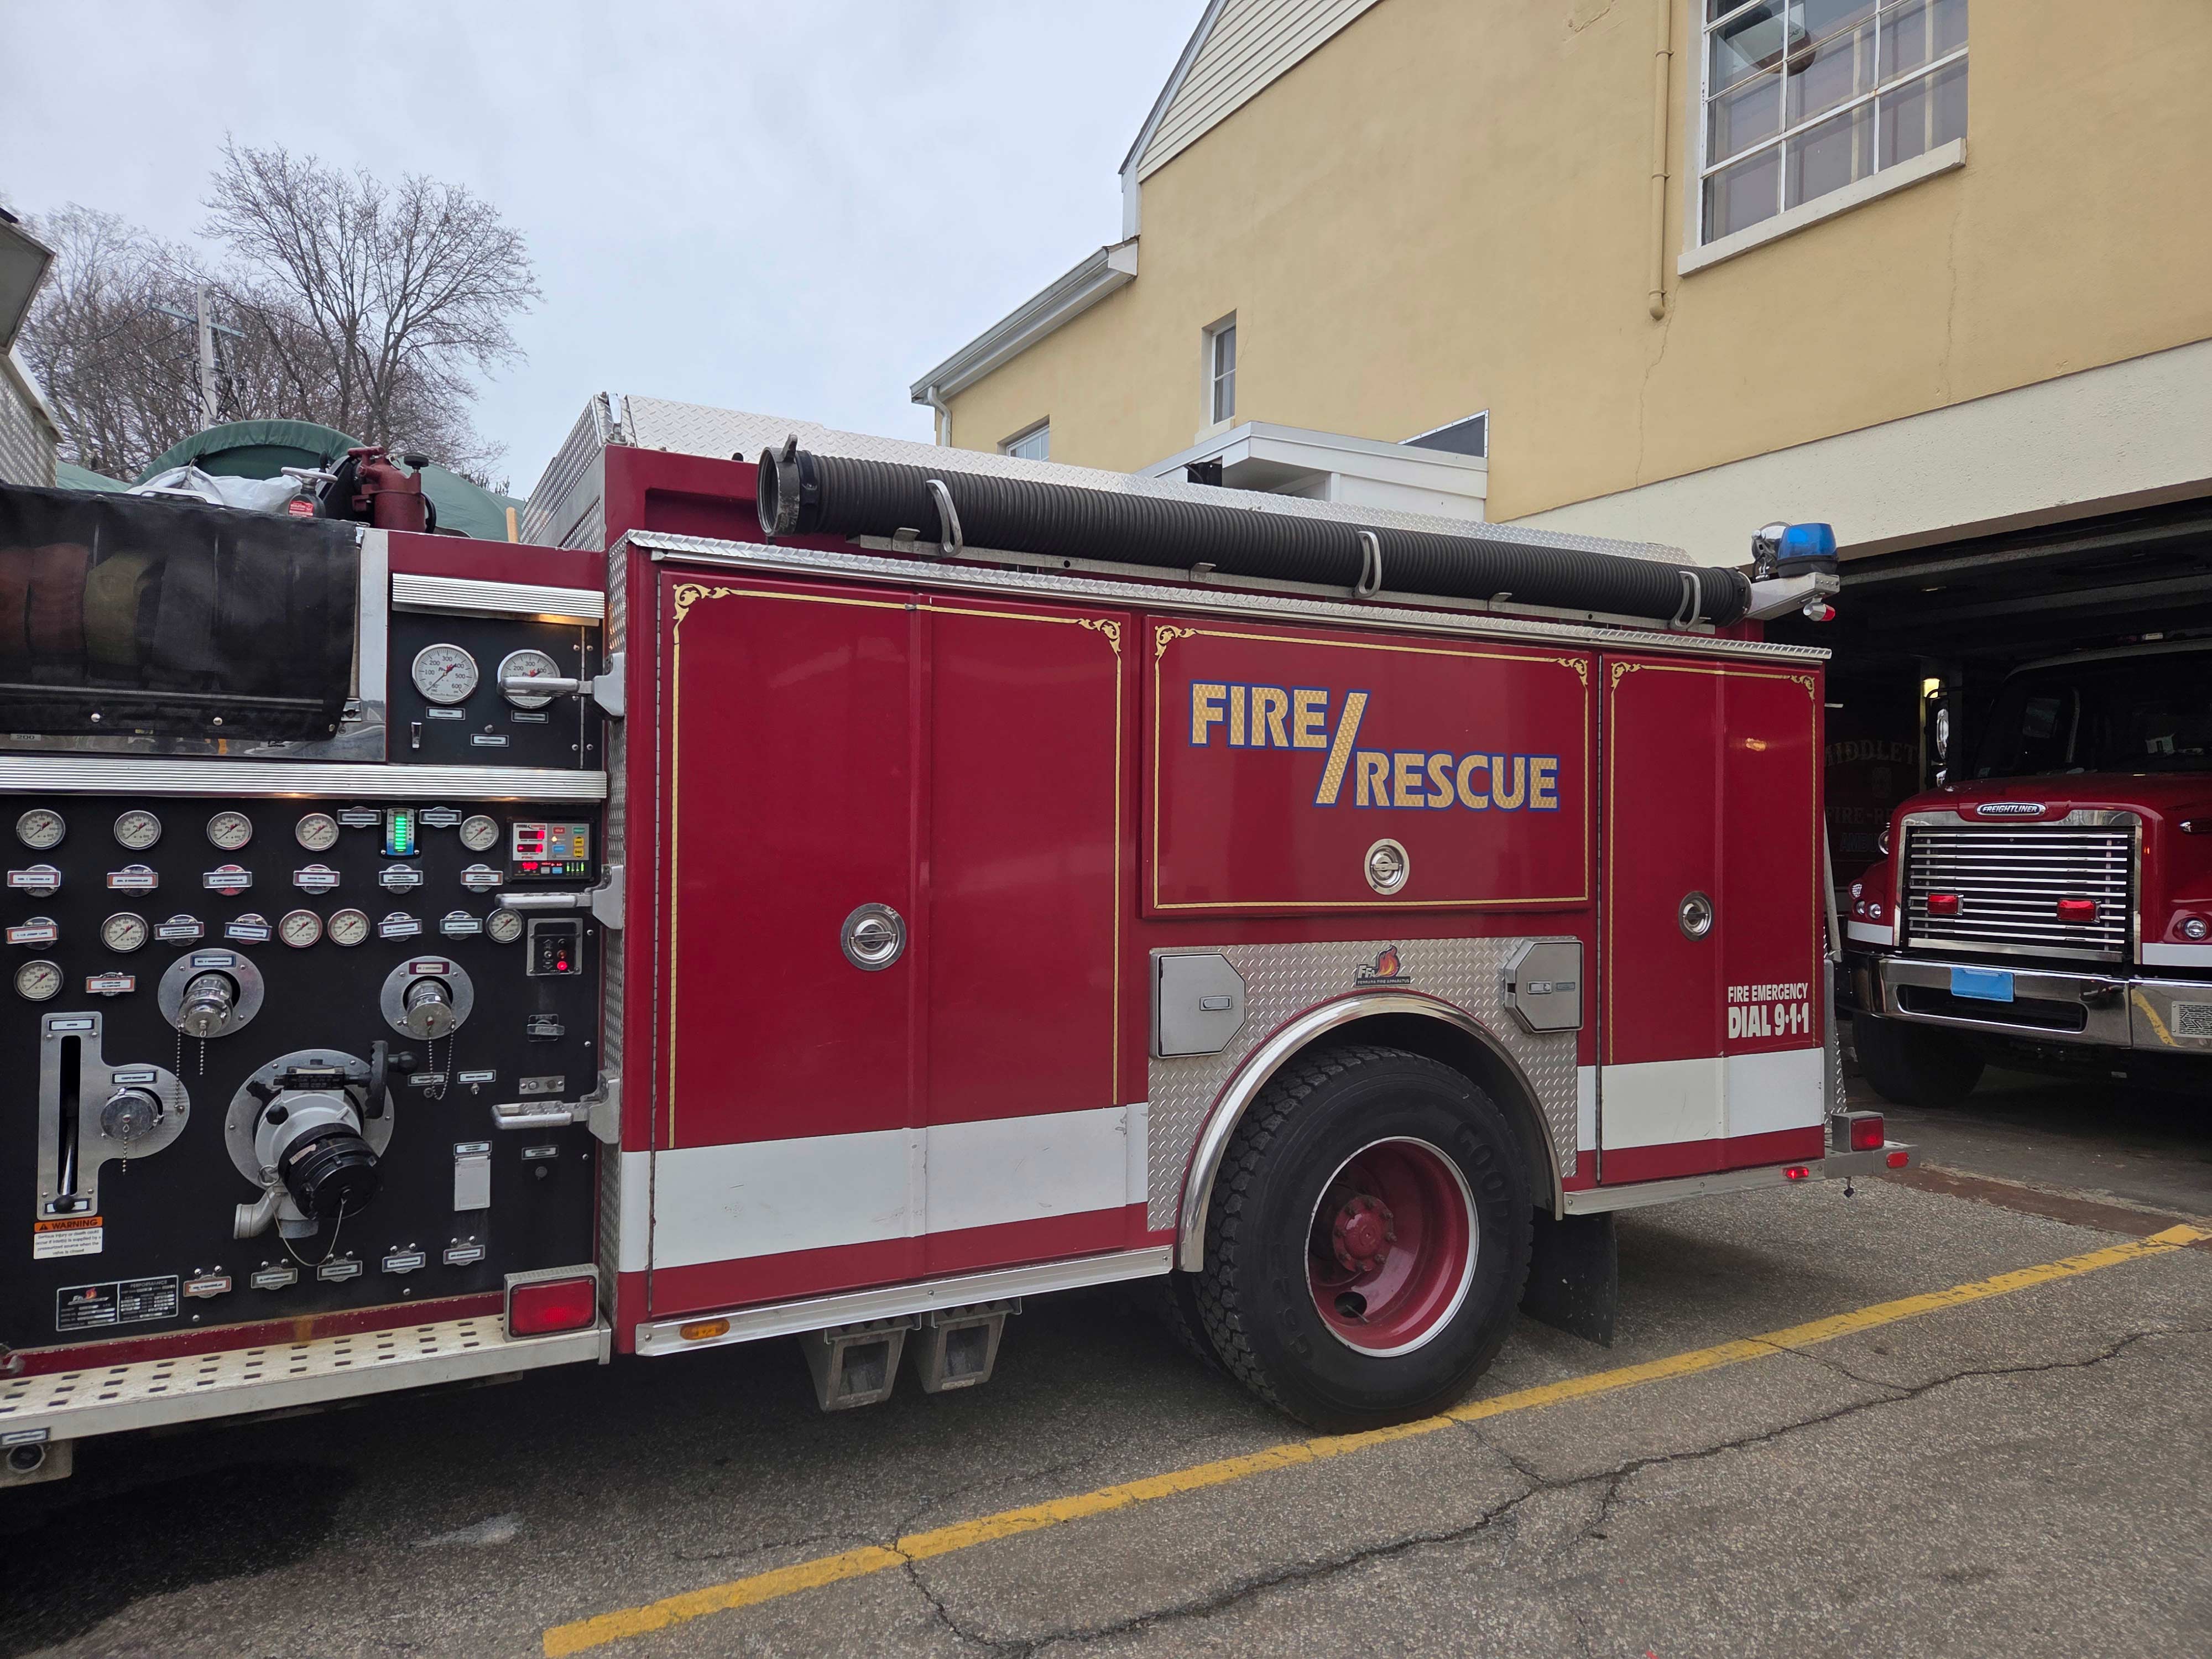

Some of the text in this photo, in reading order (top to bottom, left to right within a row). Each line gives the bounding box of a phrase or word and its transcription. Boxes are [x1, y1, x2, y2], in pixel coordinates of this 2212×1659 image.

[1781, 28, 1799, 41] LCAS
[1190, 681, 1328, 749] FIRE
[1354, 750, 1559, 811] RESCUE
[1982, 805, 2038, 813] FREIGHTLINER
[1357, 965, 1375, 978] FFA
[1728, 982, 1808, 1003] FIRE EMERGENCY
[1728, 1005, 1771, 1039] DIAL
[51, 1219, 98, 1229] WARNING
